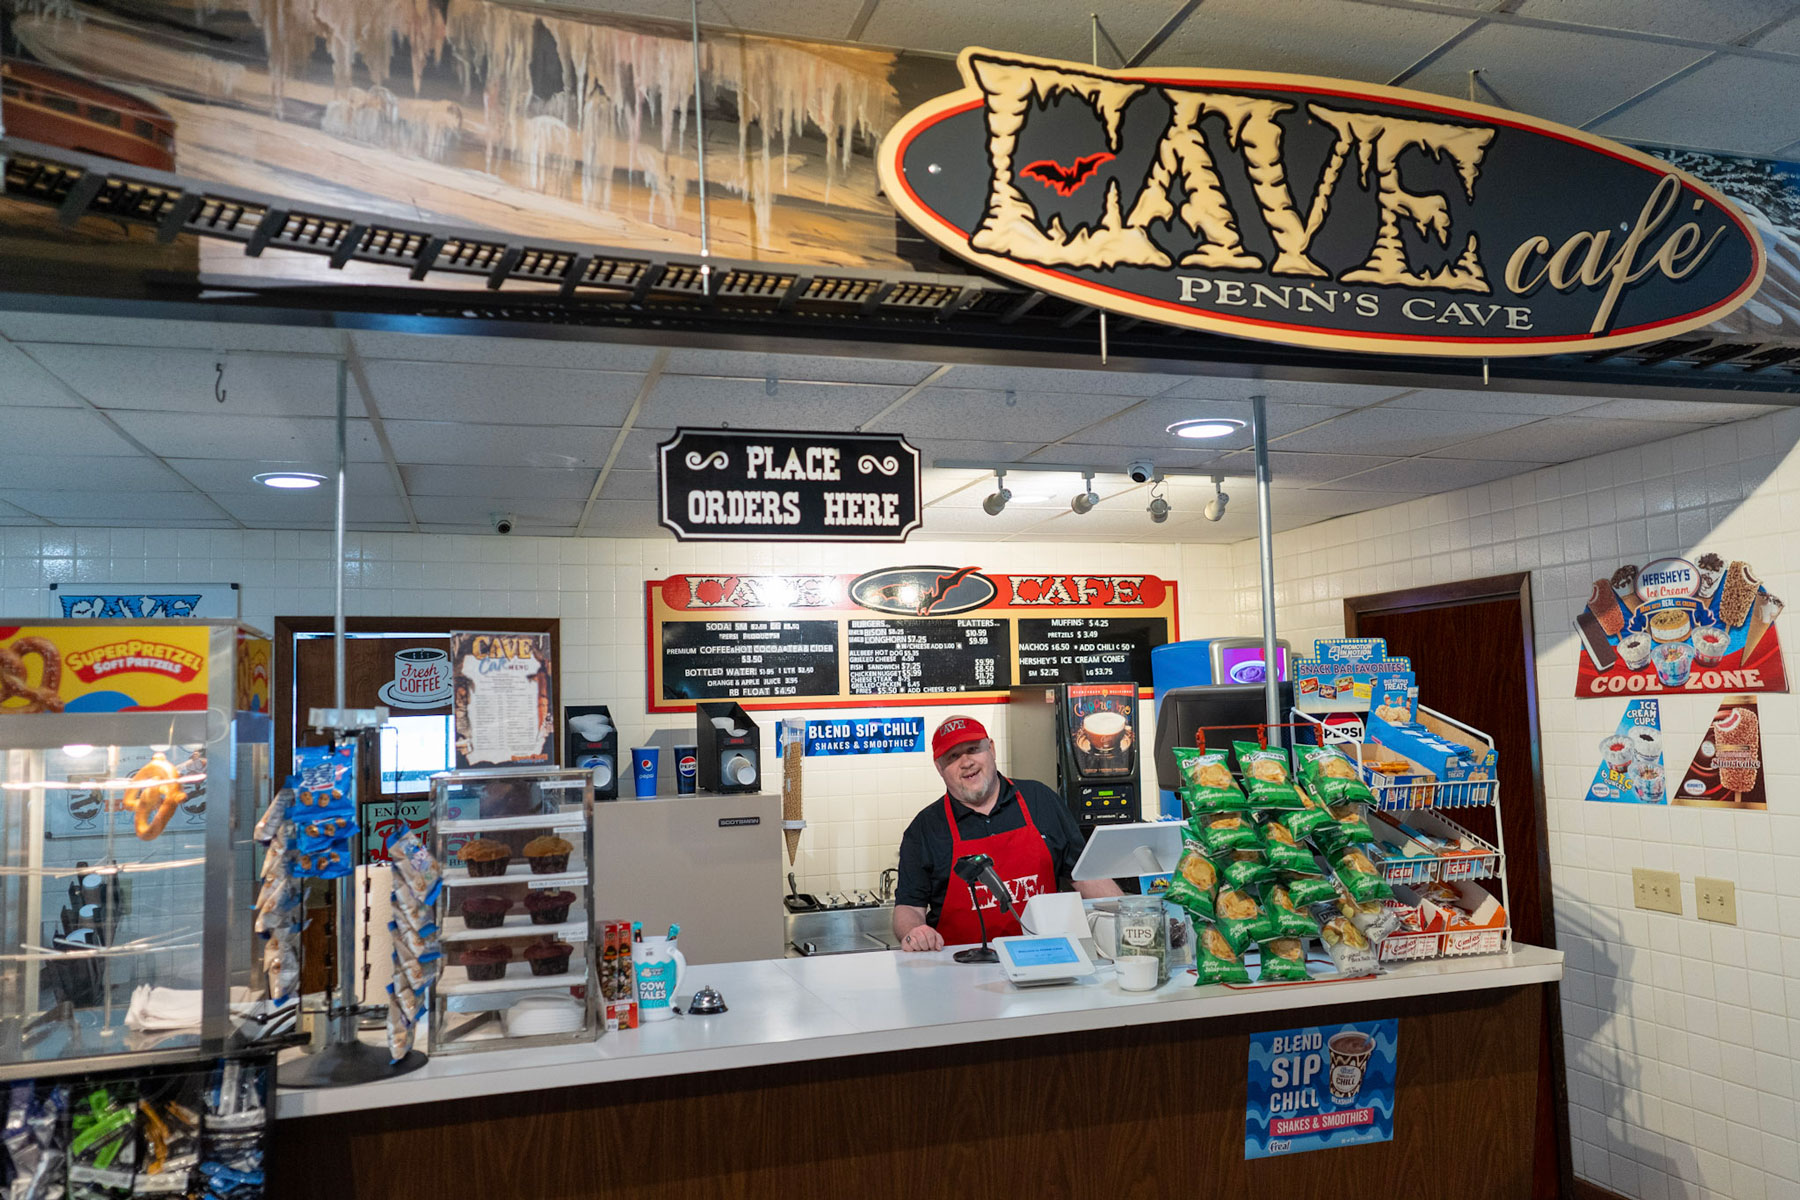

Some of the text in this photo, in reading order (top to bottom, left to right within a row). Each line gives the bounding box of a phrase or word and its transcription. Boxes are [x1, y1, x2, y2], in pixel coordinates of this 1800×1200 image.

[969, 57, 1728, 334] CAVE café
[1177, 275, 1535, 332] PENN'S CAVE
[746, 445, 841, 481] PLACE
[687, 489, 900, 527] ORDERS HERE
[1642, 568, 1691, 587] HERSHEY'S
[1008, 576, 1145, 606] CAFE
[1646, 586, 1689, 598] Ice Cream
[864, 628, 887, 636] BISON
[965, 629, 987, 637] $10.99
[864, 635, 907, 644] LONGHORN
[907, 635, 927, 643] $7.25
[968, 637, 989, 645] $9.99
[472, 636, 533, 660] CAVE
[666, 647, 697, 655] PREMIUM
[1018, 643, 1049, 651] NACHOS
[1051, 643, 1070, 651] $6.50
[1079, 643, 1095, 651] ADD
[1096, 643, 1115, 651] CHILI
[741, 655, 763, 663] $3.50
[975, 658, 995, 666] $9.99
[1019, 655, 1125, 665] HERSHEY'S ICE CREAM CONES
[93, 657, 183, 674] SOFT PRETZELS
[401, 663, 438, 678] Fresh
[901, 662, 921, 670] $7.25
[1300, 662, 1406, 675] SNACK BAR FAVORITES!
[684, 668, 723, 677] BOTTLED
[902, 669, 922, 677] $5.99
[1094, 667, 1113, 676] $3.75
[400, 676, 441, 693] COFFEE
[741, 678, 760, 686] APPLE
[763, 677, 781, 685] JUICE
[1589, 669, 1765, 694] COOL ZONE
[729, 688, 739, 696] RB
[742, 687, 770, 696] FLOAT
[1384, 683, 1408, 691] TREATS
[1640, 701, 1657, 710] ICE
[1626, 709, 1657, 718] CREAM
[1634, 718, 1656, 726] CUPS
[808, 721, 919, 739] BLEND SIP CHILL
[815, 739, 915, 751] SHAKES & SMOOTHIES
[1609, 769, 1633, 790] BIG
[1125, 928, 1152, 939] TIPS
[640, 982, 665, 991] COW
[640, 990, 666, 1000] TALES
[1272, 1033, 1323, 1054] BLEND
[1271, 1053, 1321, 1089] SIP
[1335, 1078, 1355, 1086] CHILL
[1270, 1088, 1320, 1113] CHILL
[1277, 1109, 1369, 1134] SHAKES & SMOOTHIES
